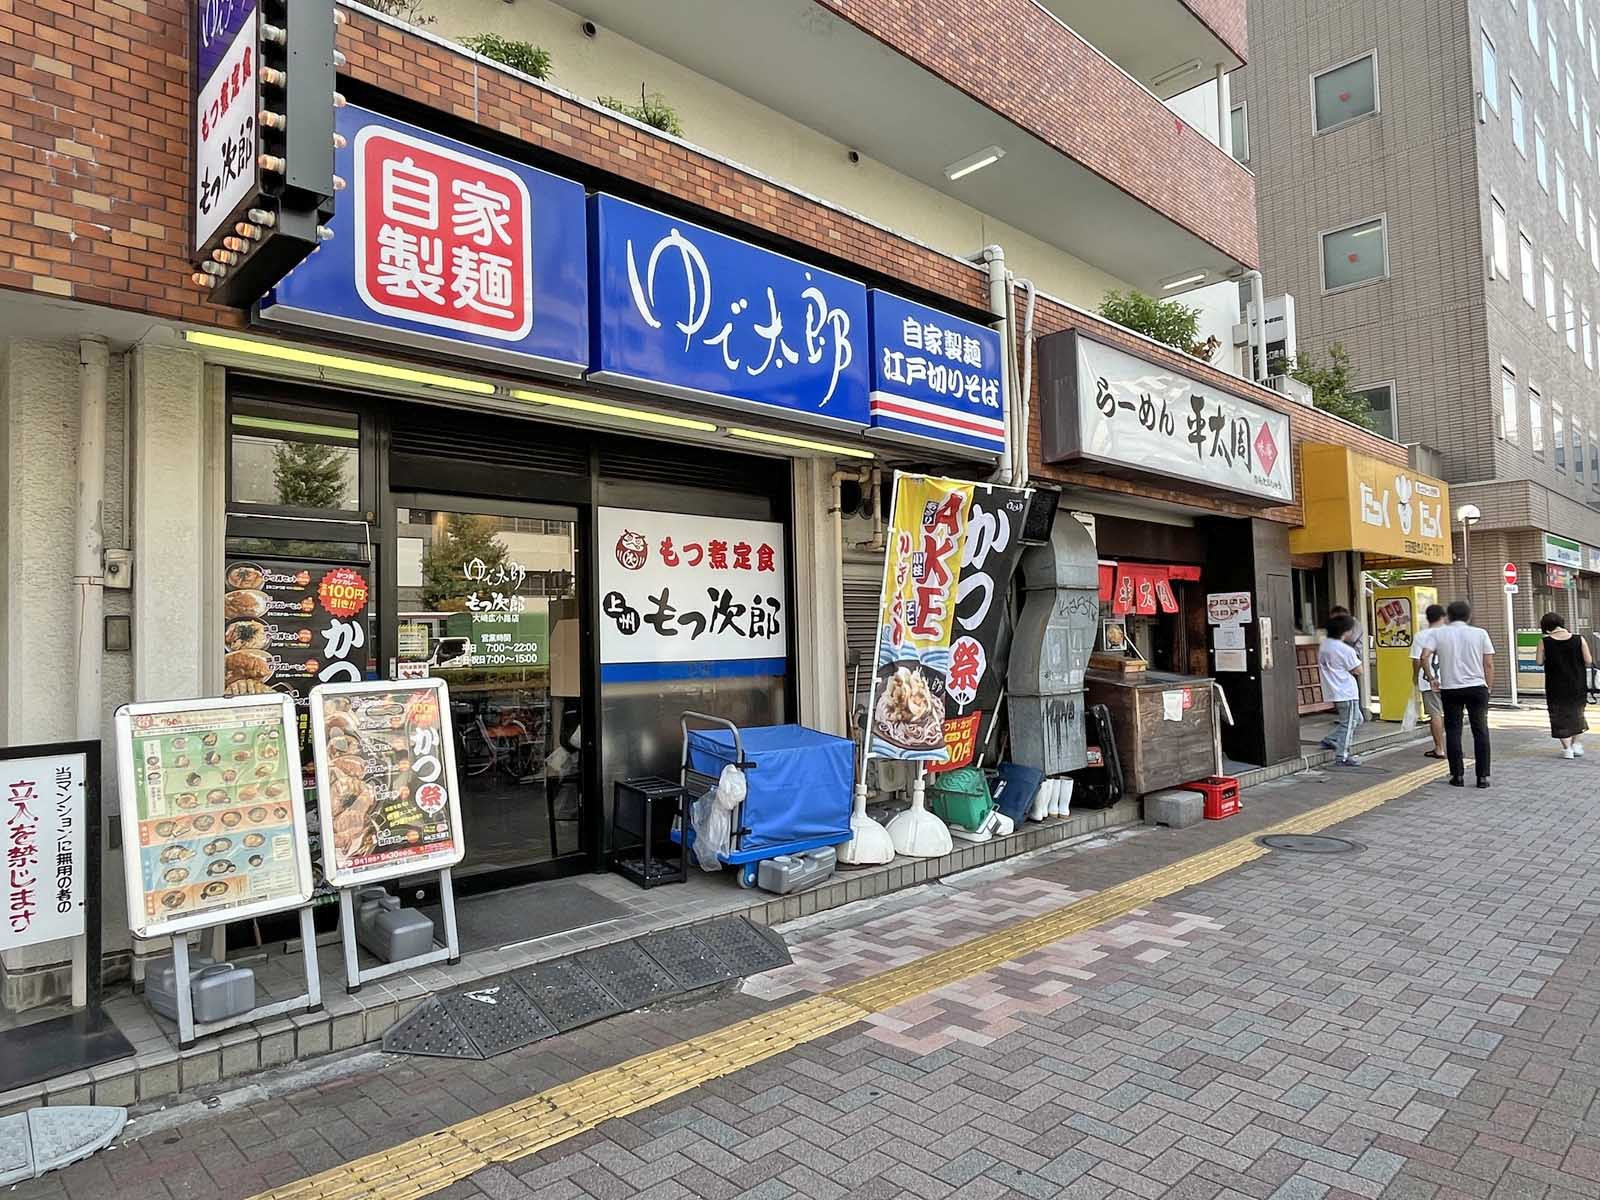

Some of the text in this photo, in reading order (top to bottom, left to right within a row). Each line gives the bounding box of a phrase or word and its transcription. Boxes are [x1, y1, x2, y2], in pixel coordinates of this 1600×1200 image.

[199, 116, 253, 215] もつ次郎
[627, 228, 854, 408] ゆで太郎
[902, 316, 983, 369] 自家製麺
[883, 347, 1000, 410] 江戸切りそば
[1096, 376, 1175, 436] らーめん
[659, 536, 776, 573] もつ煮定食
[328, 583, 366, 601] 100円
[465, 591, 525, 612] もつ次郎
[643, 587, 781, 641] もつ次郎
[481, 633, 512, 643] 営業時間
[409, 727, 442, 783] かつ
[8, 779, 39, 933] 立入を禁じます
[55, 766, 73, 914] 当マンションに無用の者の
